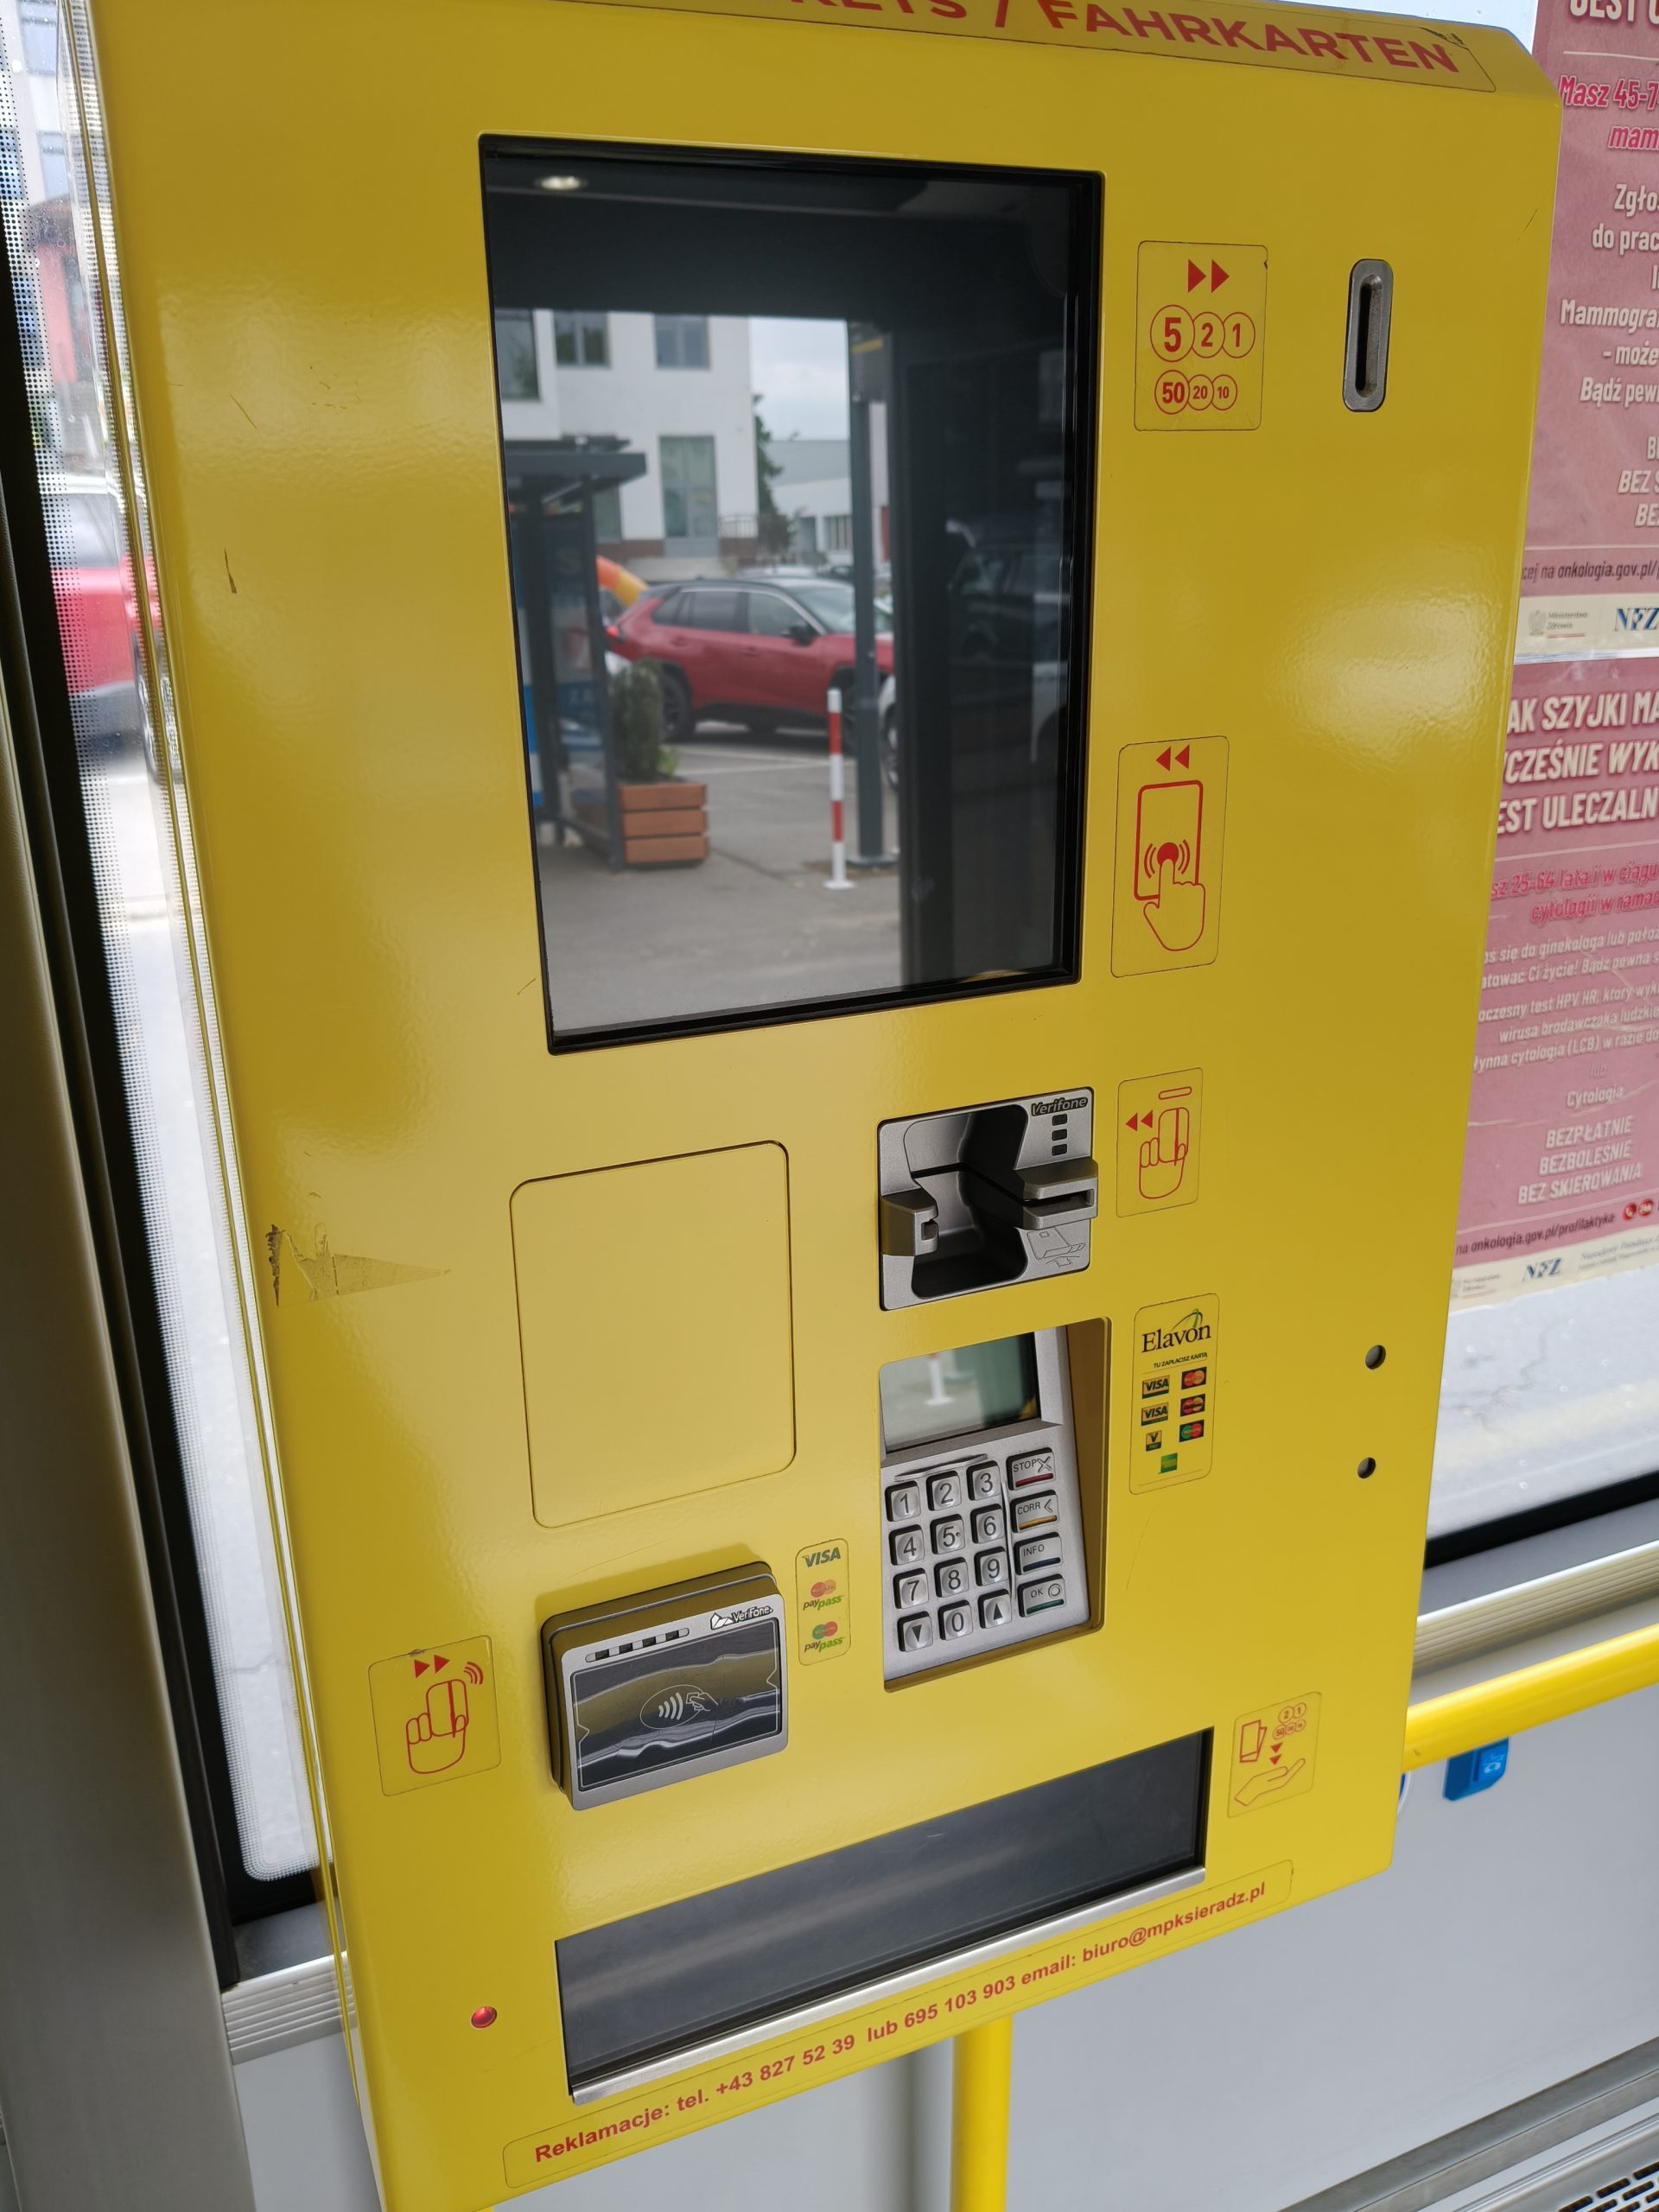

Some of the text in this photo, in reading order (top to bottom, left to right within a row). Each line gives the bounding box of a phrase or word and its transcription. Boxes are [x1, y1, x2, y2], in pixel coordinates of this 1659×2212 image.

[1040, 0, 1459, 73] FAHRKARTEN
[1559, 74, 1659, 111] Masz 45-7
[1614, 183, 1659, 217] Zgło
[1592, 223, 1659, 256] do prac
[1560, 299, 1659, 334] Mammogra
[1164, 316, 1241, 353] 5 2 1
[1615, 340, 1659, 365] może
[1161, 381, 1230, 404] 50 20 10
[1580, 377, 1659, 408] Bądź pew
[1618, 469, 1651, 493] BEZ
[1635, 503, 1659, 526] BE
[1540, 565, 1554, 579] na
[1557, 560, 1659, 582] onkologia.gov.pl/
[1541, 692, 1628, 731] SZYJKI
[1503, 738, 1659, 785] CZEŚNIE WYK
[1542, 786, 1659, 830] ULECZALN
[1510, 871, 1555, 896] 25-64
[1559, 868, 1590, 888] lata
[1603, 868, 1615, 883] w
[1531, 893, 1598, 927] cytologii
[1600, 898, 1613, 913] w
[1499, 945, 1518, 963] się
[1521, 943, 1536, 959] do
[1539, 935, 1605, 959] ginekologa
[1607, 931, 1624, 947] lub
[1529, 964, 1540, 982] Ci
[1541, 959, 1579, 982] życie!
[1612, 951, 1649, 969] pewna
[1530, 998, 1554, 1014] test
[1556, 992, 1579, 1010] HPV
[1635, 981, 1659, 1001] wyk
[1499, 1026, 1538, 1044] wirusa
[1541, 1011, 1618, 1036] brodawczaka
[1511, 1042, 1564, 1066] cytologia
[1603, 1037, 1612, 1049] w
[1614, 1031, 1643, 1048] razie
[1032, 1096, 1088, 1116] Verifone
[1567, 1084, 1624, 1109] Cytologia
[1546, 1115, 1633, 1148] BEZPŁATNIE
[1538, 1139, 1632, 1176] BEZBOLEŚNIE
[1517, 1161, 1643, 1205] BEZ SKIEROWANIA
[1471, 1213, 1616, 1252] onkologia.gov.pl/profilaktyka
[1141, 1323, 1211, 1353] Elavon
[1145, 1378, 1169, 1391] VISA
[1144, 1405, 1168, 1419] VISA
[1013, 1459, 1037, 1473] STOP
[941, 1483, 954, 1504] 2
[980, 1472, 993, 1493] 3
[899, 1493, 909, 1514] 1
[1017, 1502, 1040, 1516] CORR
[943, 1526, 956, 1547] 5
[983, 1516, 996, 1536] 6
[802, 1547, 842, 1567] VISA
[903, 1536, 917, 1556] 4
[1023, 1544, 1045, 1557] INFO
[948, 1569, 961, 1591] 8
[987, 1558, 1000, 1579] 9
[907, 1580, 919, 1602] 7
[1030, 1587, 1044, 1599] OK
[951, 1611, 964, 1632] 0
[1284, 1707, 1301, 1719] 2 1
[1275, 1728, 1285, 1737] 50
[534, 1881, 1267, 2163] Reklamacje: tel. +43 827 52 39 lub 695 103 903 email: biuro@mpksieradz.pl
